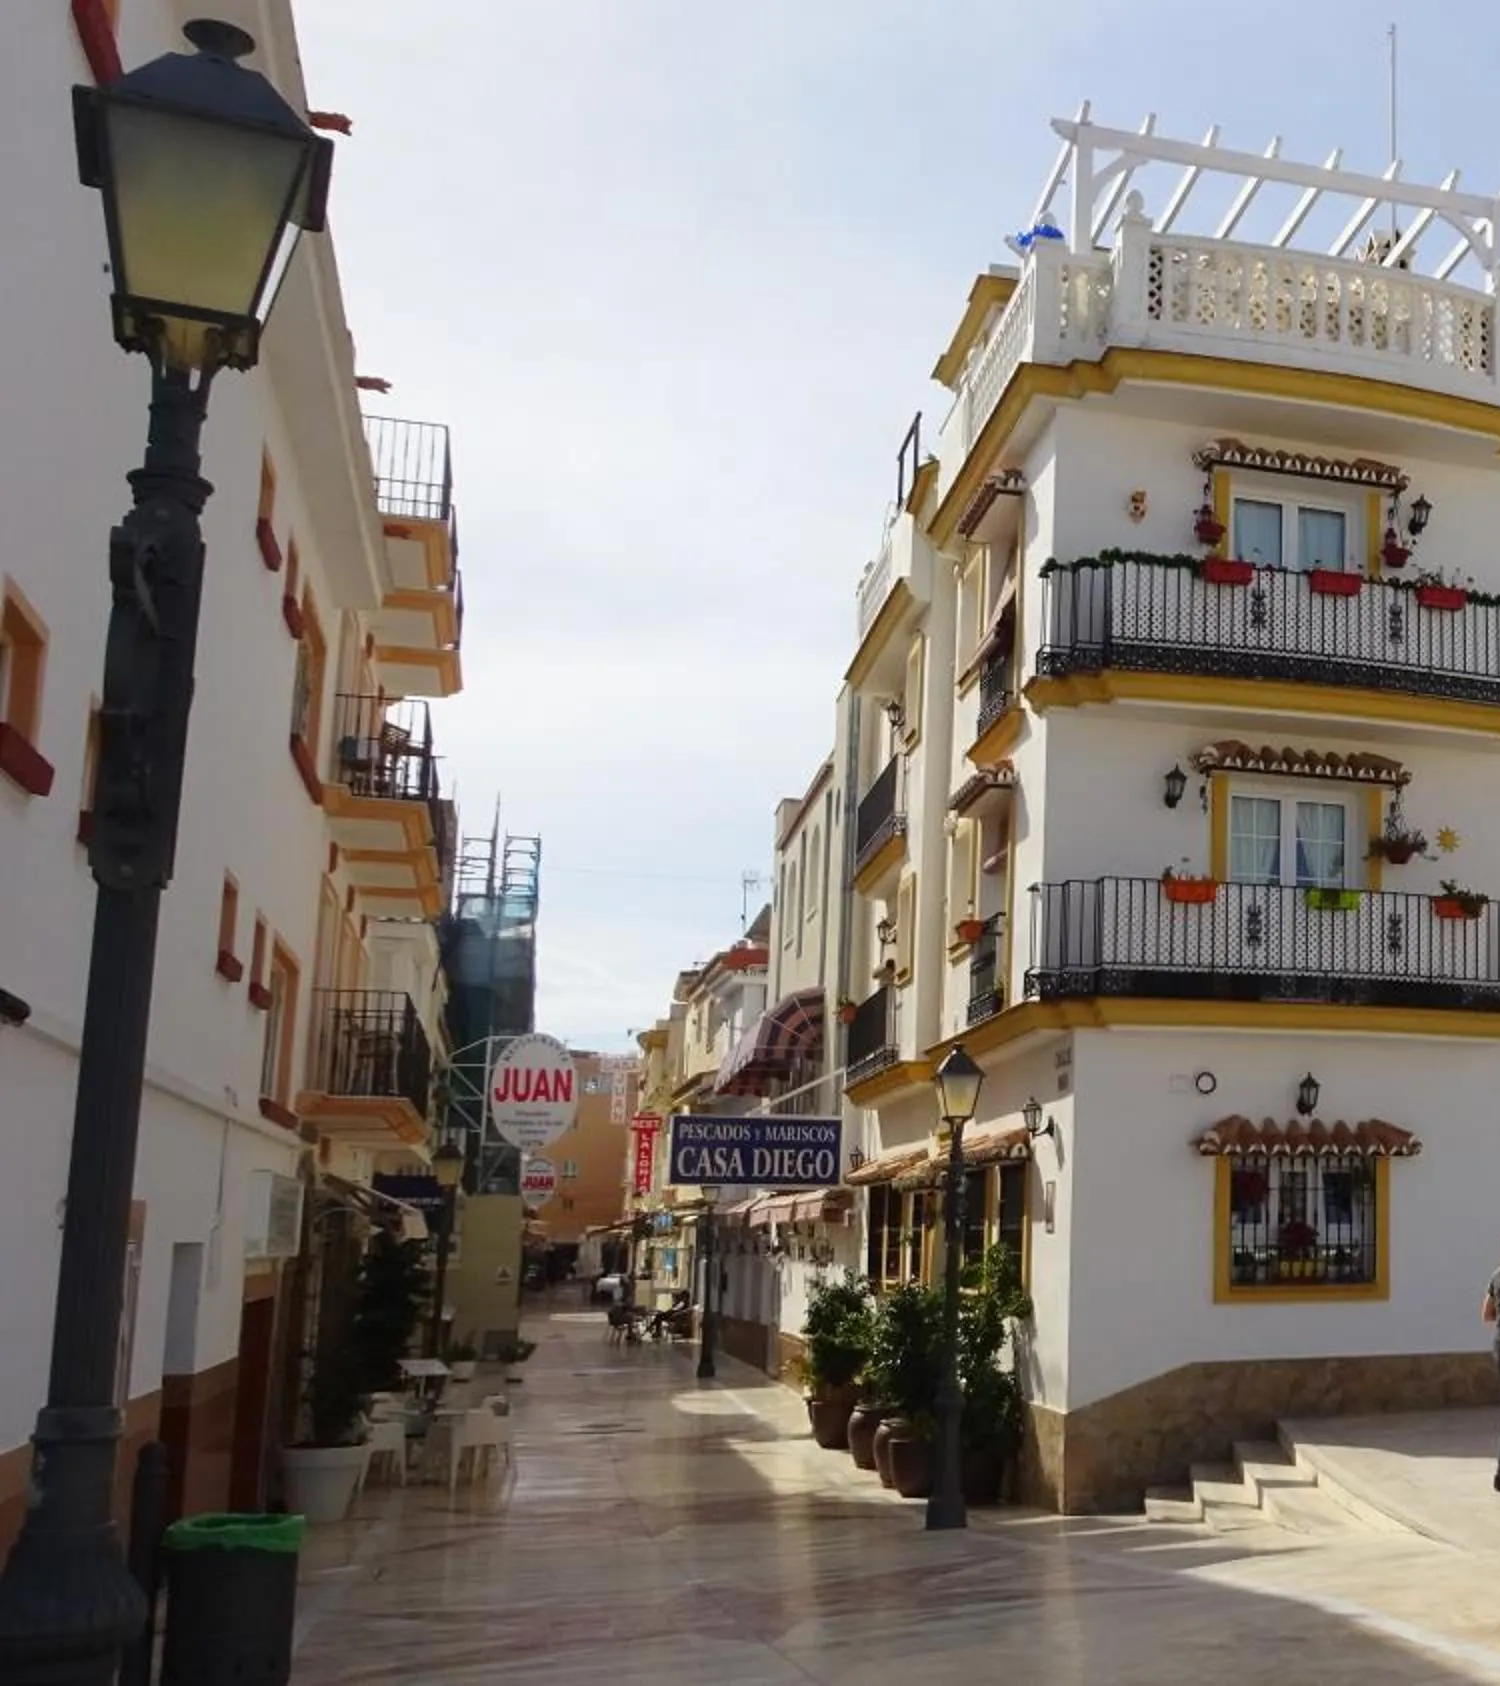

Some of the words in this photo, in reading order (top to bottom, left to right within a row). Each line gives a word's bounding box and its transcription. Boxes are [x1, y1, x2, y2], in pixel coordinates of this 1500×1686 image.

[494, 1067, 573, 1103] JUAN
[678, 1122, 751, 1141] PESCADOS
[765, 1125, 836, 1142] MARISCOS
[676, 1146, 745, 1178] CASA
[752, 1148, 835, 1179] DIEGO
